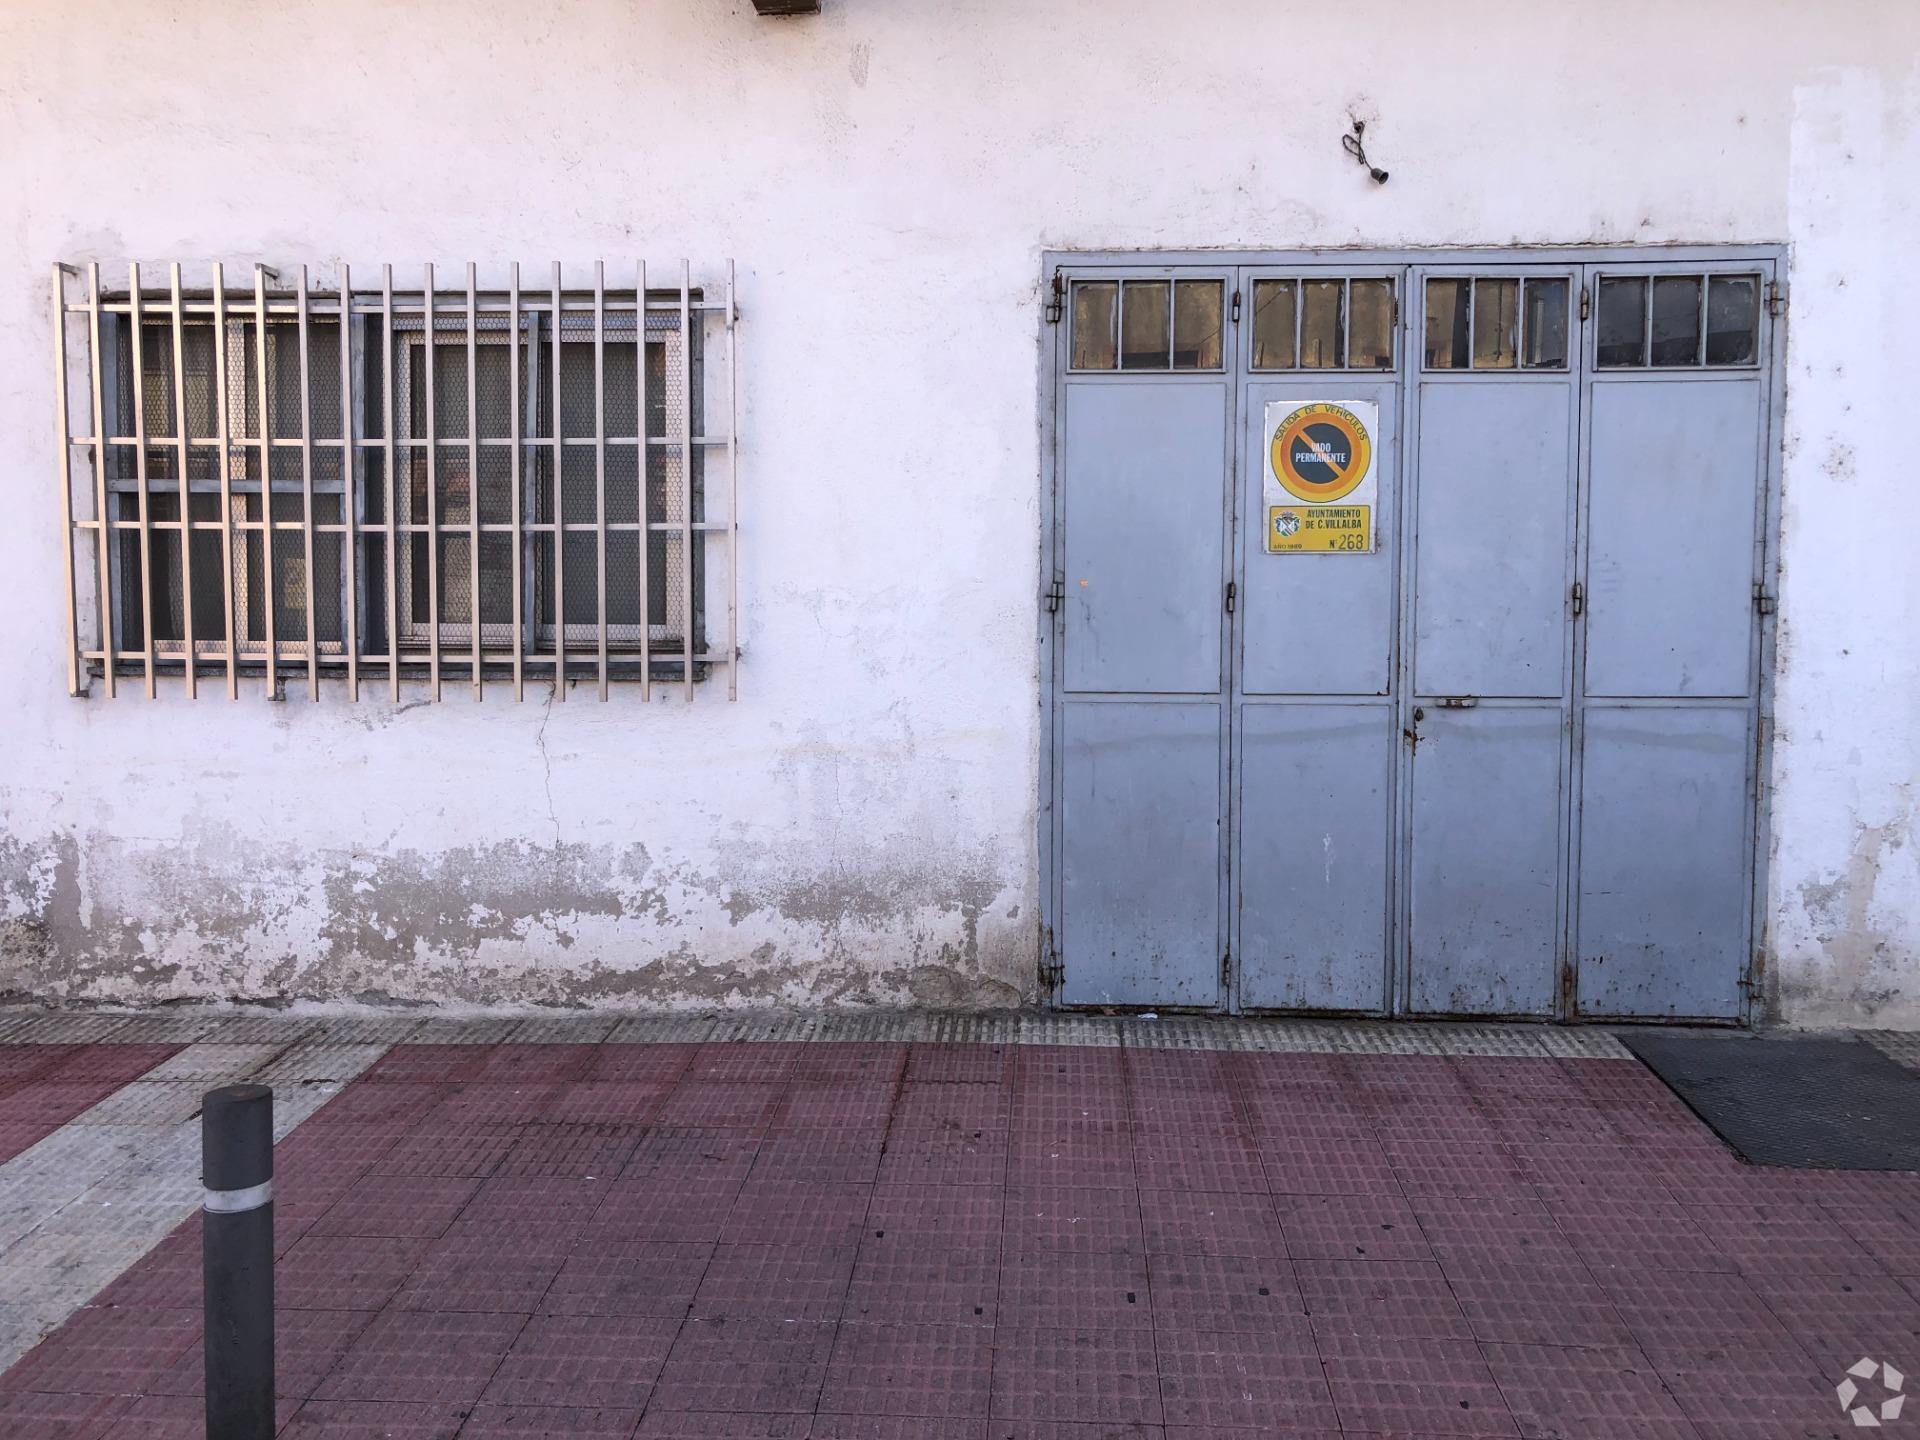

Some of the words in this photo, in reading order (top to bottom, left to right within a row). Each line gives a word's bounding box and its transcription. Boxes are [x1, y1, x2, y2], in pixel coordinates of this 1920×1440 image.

[1275, 414, 1301, 442] SALIDA
[1304, 405, 1317, 415] DE
[1311, 443, 1332, 453] VADO
[1295, 452, 1346, 463] PERMANENTE
[1307, 509, 1361, 518] AYUNTAMIENTO
[1305, 520, 1314, 529] DE
[1317, 519, 1362, 529] C.VILLALBA
[1338, 533, 1364, 550] 268
